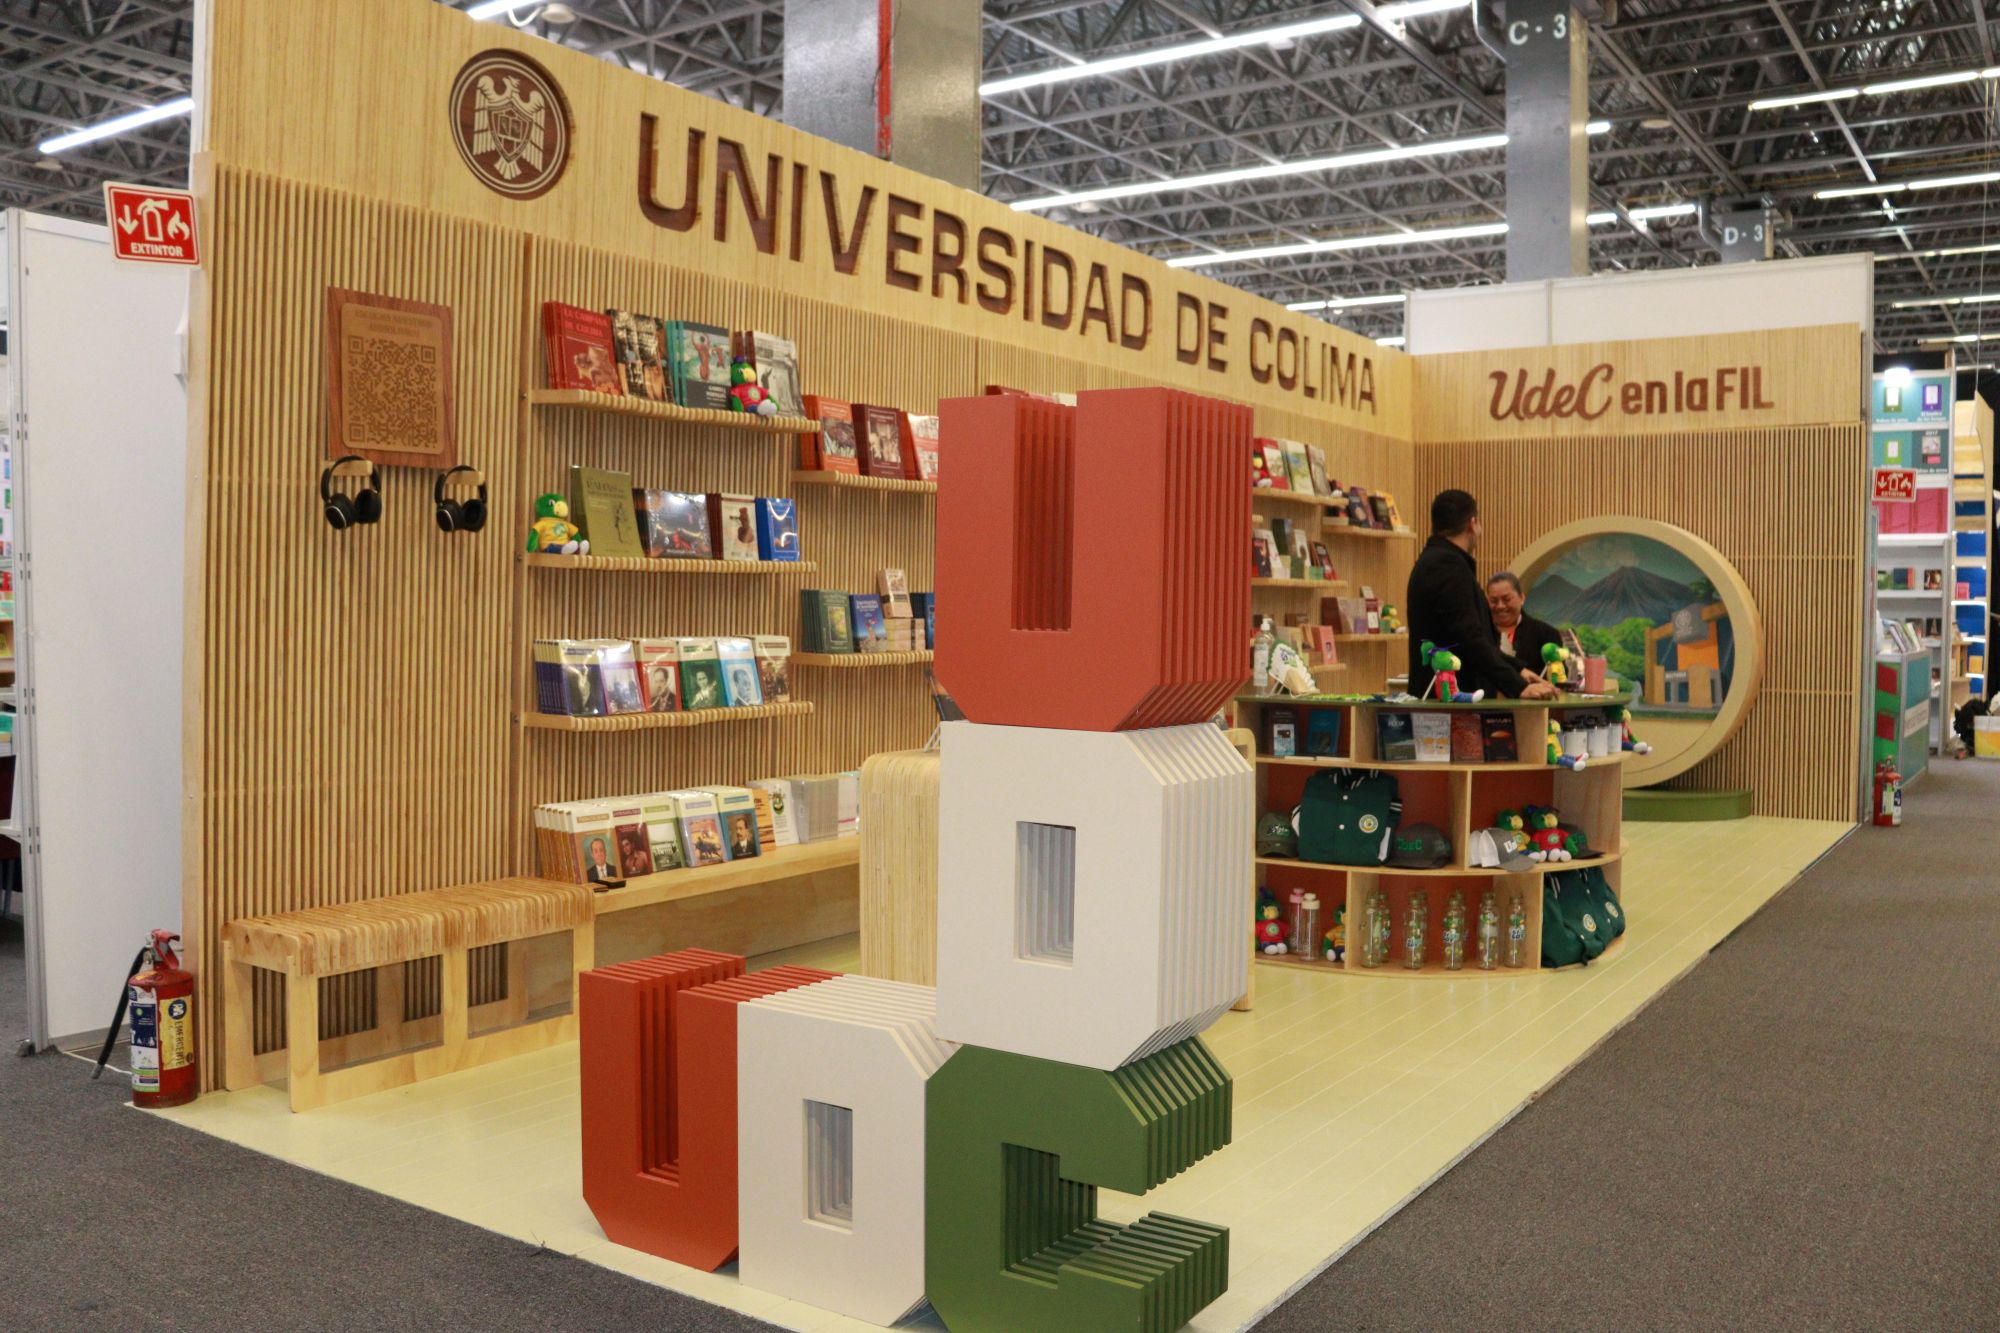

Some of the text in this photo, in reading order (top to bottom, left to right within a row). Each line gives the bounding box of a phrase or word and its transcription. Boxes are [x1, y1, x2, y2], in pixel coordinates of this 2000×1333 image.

[130, 242, 184, 258] EXTINTOR
[637, 111, 1377, 416] UNIVERSIDAD DE COLIMA
[1488, 363, 1775, 422] UdeC en la FIL
